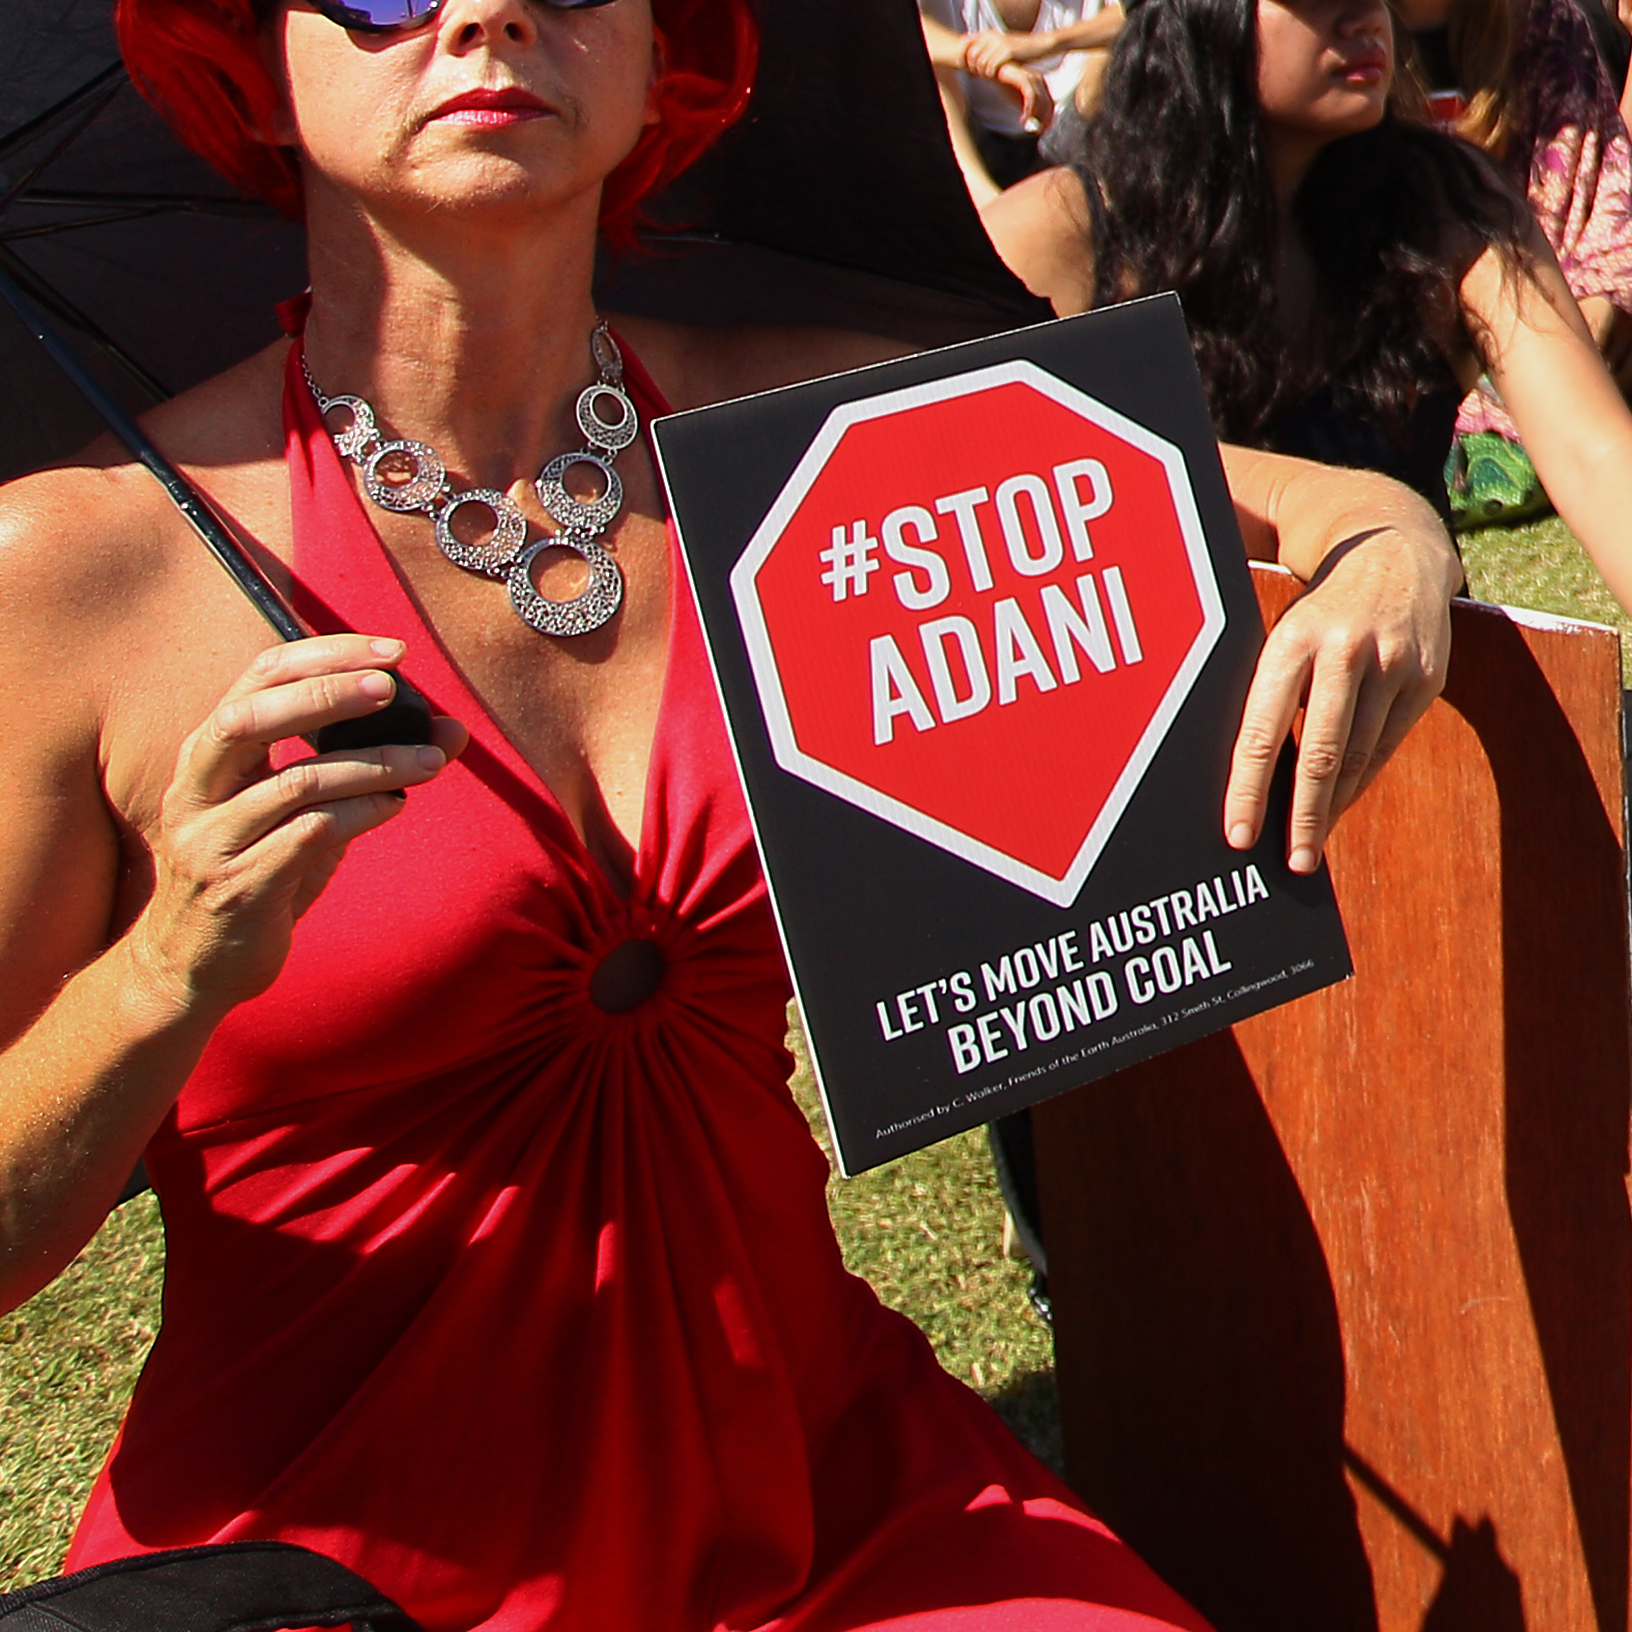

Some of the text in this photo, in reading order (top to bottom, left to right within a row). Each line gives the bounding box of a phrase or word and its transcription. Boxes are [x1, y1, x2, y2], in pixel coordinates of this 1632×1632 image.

[817, 456, 1115, 611] #STOP
[868, 564, 1144, 747] ADANI
[876, 864, 1270, 1043] LET'S MOVE AUSTRALIA
[946, 929, 1233, 1075] BEYOND COAL
[874, 1108, 936, 1139] Authorised
[935, 1104, 951, 1118] by
[1007, 1065, 1048, 1087] Friends
[1048, 1059, 1061, 1071] of
[1061, 1052, 1080, 1065] the
[1080, 1037, 1110, 1058] Earth
[1159, 1012, 1180, 1026] 312
[1180, 999, 1212, 1019] Smith
